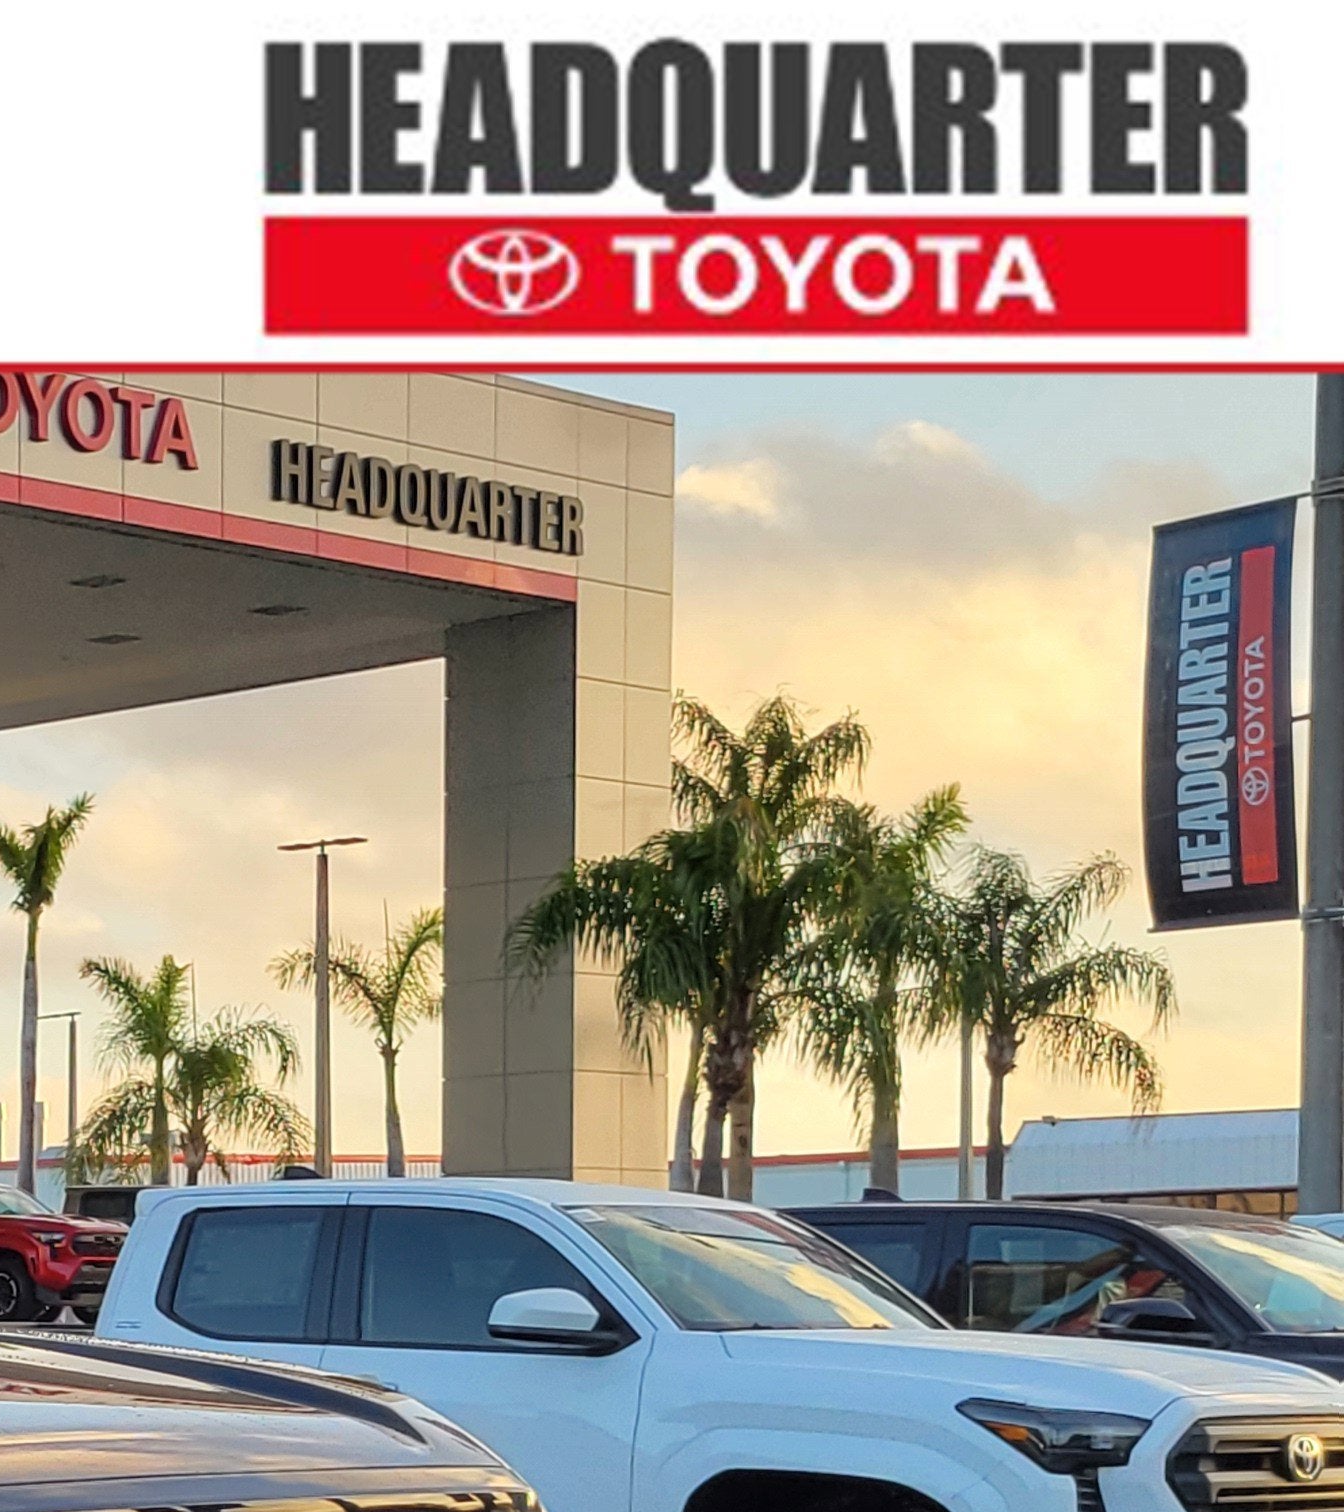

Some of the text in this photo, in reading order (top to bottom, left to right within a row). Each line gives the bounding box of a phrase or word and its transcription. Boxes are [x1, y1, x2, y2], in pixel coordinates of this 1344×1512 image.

[271, 439, 584, 555] HEADQUARTER
[1175, 556, 1233, 893] HEADQUARTER
[1243, 635, 1265, 765] TOYOTA
